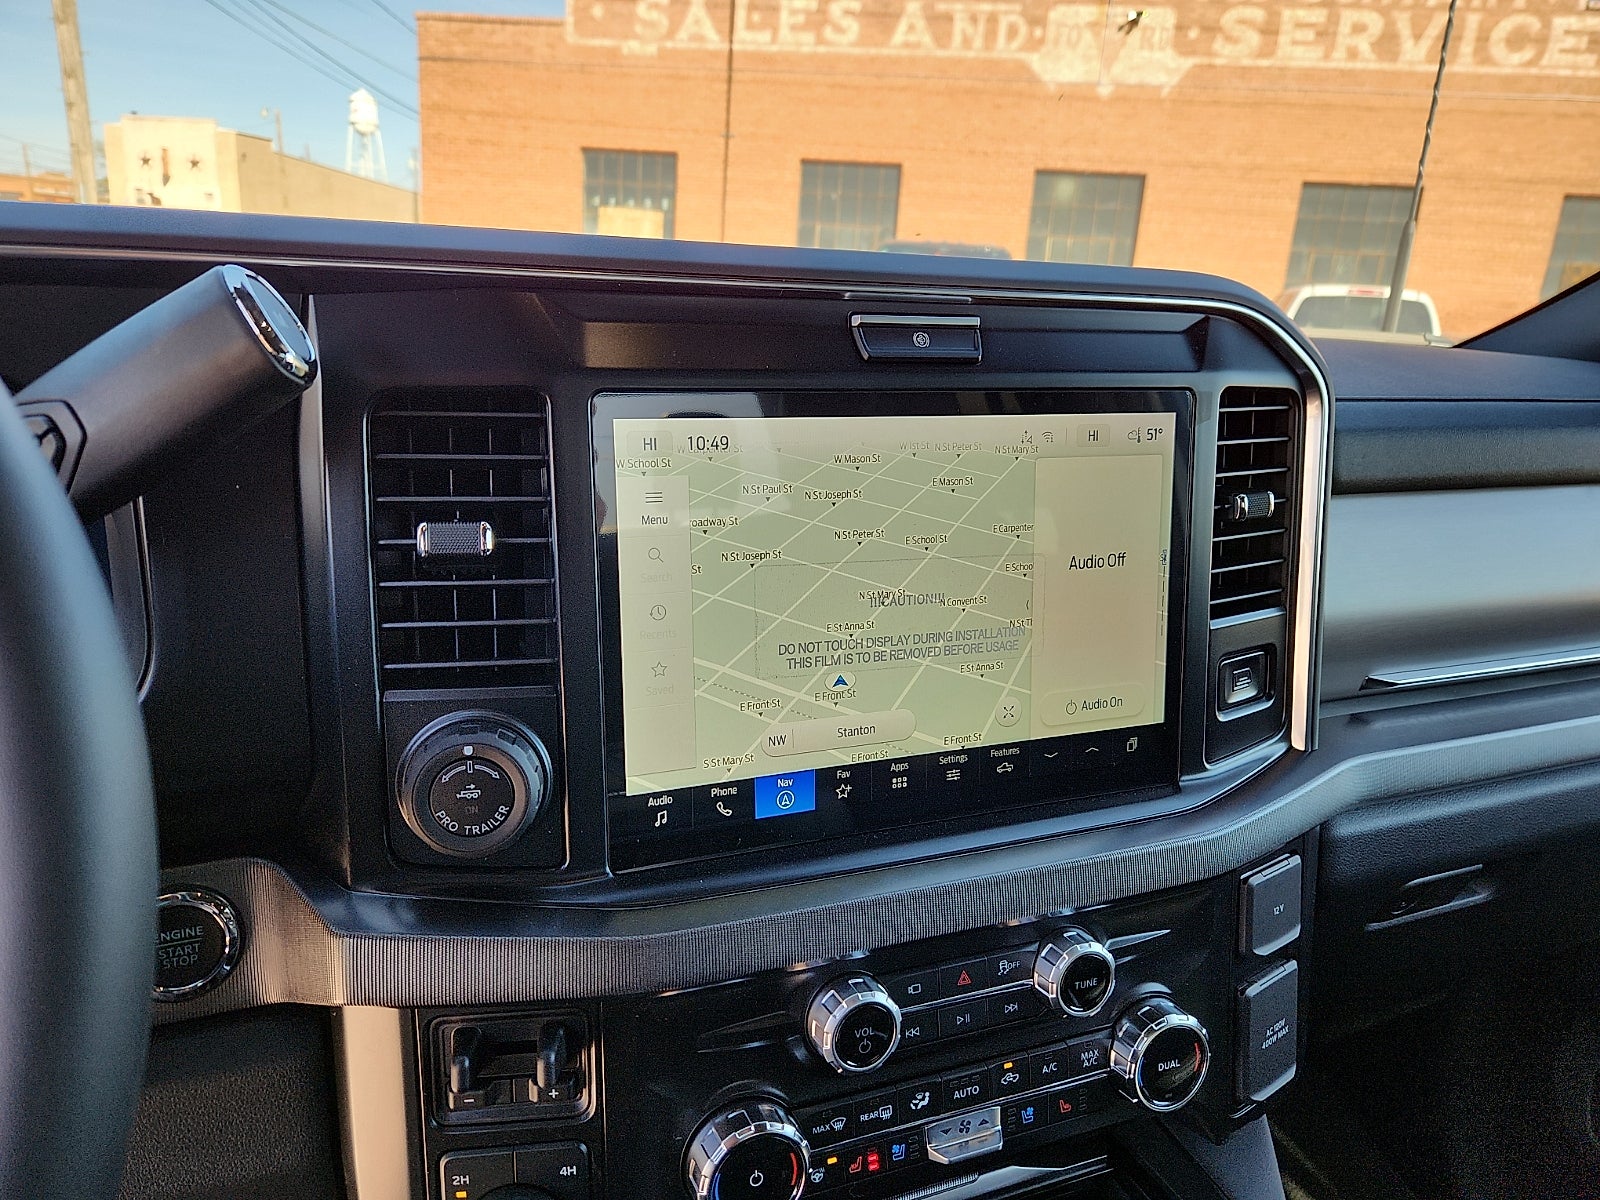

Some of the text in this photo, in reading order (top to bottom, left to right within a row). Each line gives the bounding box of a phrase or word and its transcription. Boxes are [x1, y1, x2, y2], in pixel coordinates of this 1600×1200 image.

[634, 0, 861, 45] SALES
[890, 0, 1027, 51] AND
[1211, 5, 1600, 67] SERVICE
[1088, 430, 1099, 442] HI
[643, 437, 657, 451] HI
[687, 435, 729, 451] 10:49
[920, 441, 930, 450] St
[935, 442, 982, 452] N St Peter St
[995, 445, 1039, 455] N St Mary St
[616, 458, 671, 469] W School St
[834, 454, 881, 464] W Mason St
[932, 477, 974, 487] E Mason St
[742, 484, 793, 495] N St Paul St
[805, 489, 862, 502] N St Joseph St
[641, 515, 668, 525] Menu
[690, 516, 739, 530] roadway St
[834, 528, 885, 540] N St Peter St
[993, 523, 1034, 534] E Carpenter
[906, 534, 948, 545] E School St
[721, 550, 782, 563] N St Joseph St
[1069, 551, 1127, 571] Audio Off
[691, 565, 702, 574] St
[1005, 563, 1010, 571] E
[859, 592, 865, 600] N
[866, 591, 876, 600] St
[897, 589, 906, 598] St
[940, 596, 988, 607] N Convent St
[826, 621, 875, 633] E St Anna St
[1010, 619, 1015, 628] N
[1016, 619, 1024, 628] St
[778, 626, 1026, 656] DO NOT TOUCH DISPLAY DURING INSTALLATION
[786, 639, 1019, 670] THIS FILM IS TO BE REMOVED BEFORE USAGE
[960, 661, 1004, 674] E St Anna St
[814, 688, 856, 702] E Front St
[740, 699, 781, 712] E Front St
[1081, 696, 1123, 711] Audio On
[837, 724, 876, 738] Stanton
[768, 734, 787, 747] NW
[944, 733, 982, 746] E Front St
[851, 749, 889, 762] E Front St
[990, 746, 1020, 757] Features
[703, 753, 754, 769] S St Mary St
[939, 753, 968, 765] Settings
[890, 761, 909, 773] Apps
[836, 769, 851, 780] Fav
[777, 777, 794, 788] Nav
[711, 785, 738, 798] Phone
[647, 795, 673, 807] Audio
[435, 804, 510, 835] PRO TRAILER
[158, 943, 200, 960] START
[163, 954, 199, 969] STOP
[1007, 961, 1021, 970] OFF
[1074, 977, 1098, 990] TUNE
[854, 1027, 875, 1038] VOL
[1081, 1049, 1099, 1061] MAX
[1042, 1062, 1058, 1074] A/C
[1083, 1056, 1098, 1068] A/C
[1157, 1059, 1181, 1072] DUAL
[953, 1085, 980, 1100] AUTO
[860, 1110, 879, 1122] REAR
[812, 1123, 831, 1134] MAX
[559, 1165, 577, 1176] 4H
[451, 1175, 470, 1185] 2H
